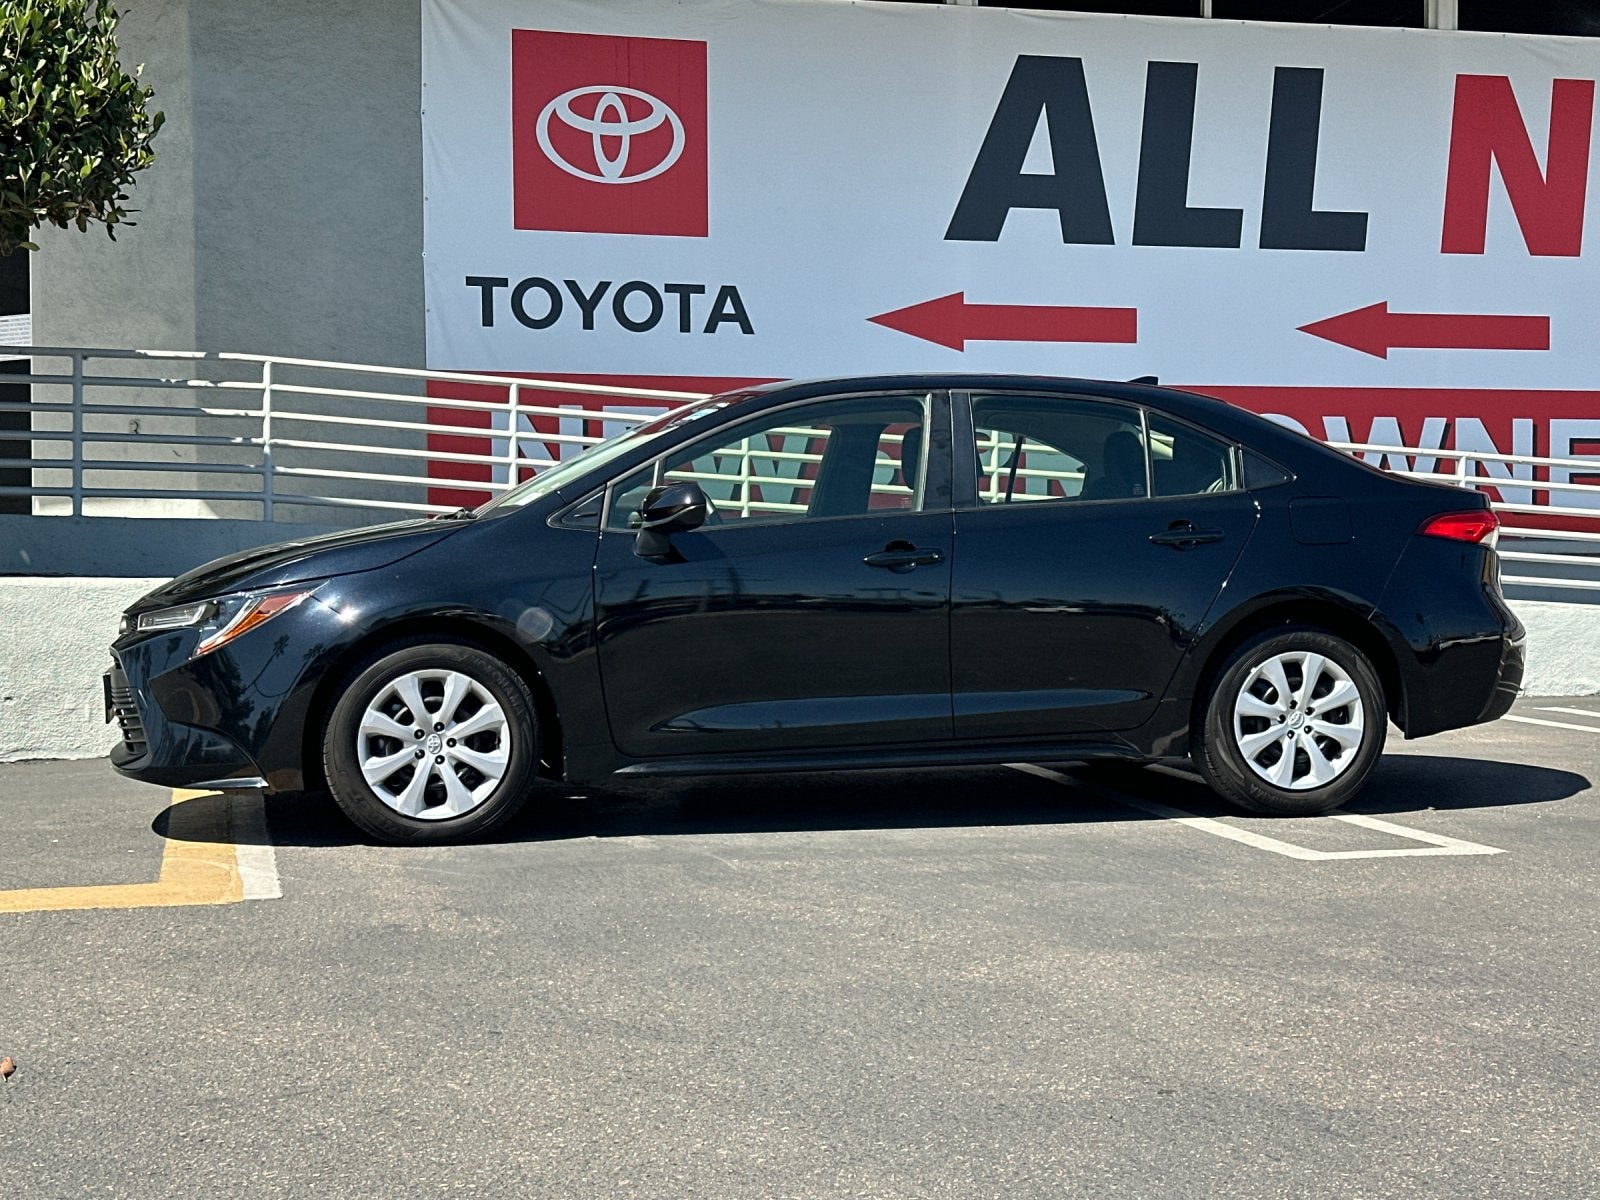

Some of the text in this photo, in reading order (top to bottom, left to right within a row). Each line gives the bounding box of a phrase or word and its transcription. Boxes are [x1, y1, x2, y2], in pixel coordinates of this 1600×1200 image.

[944, 54, 1596, 257] ALL N
[465, 275, 755, 335] TOYOTA
